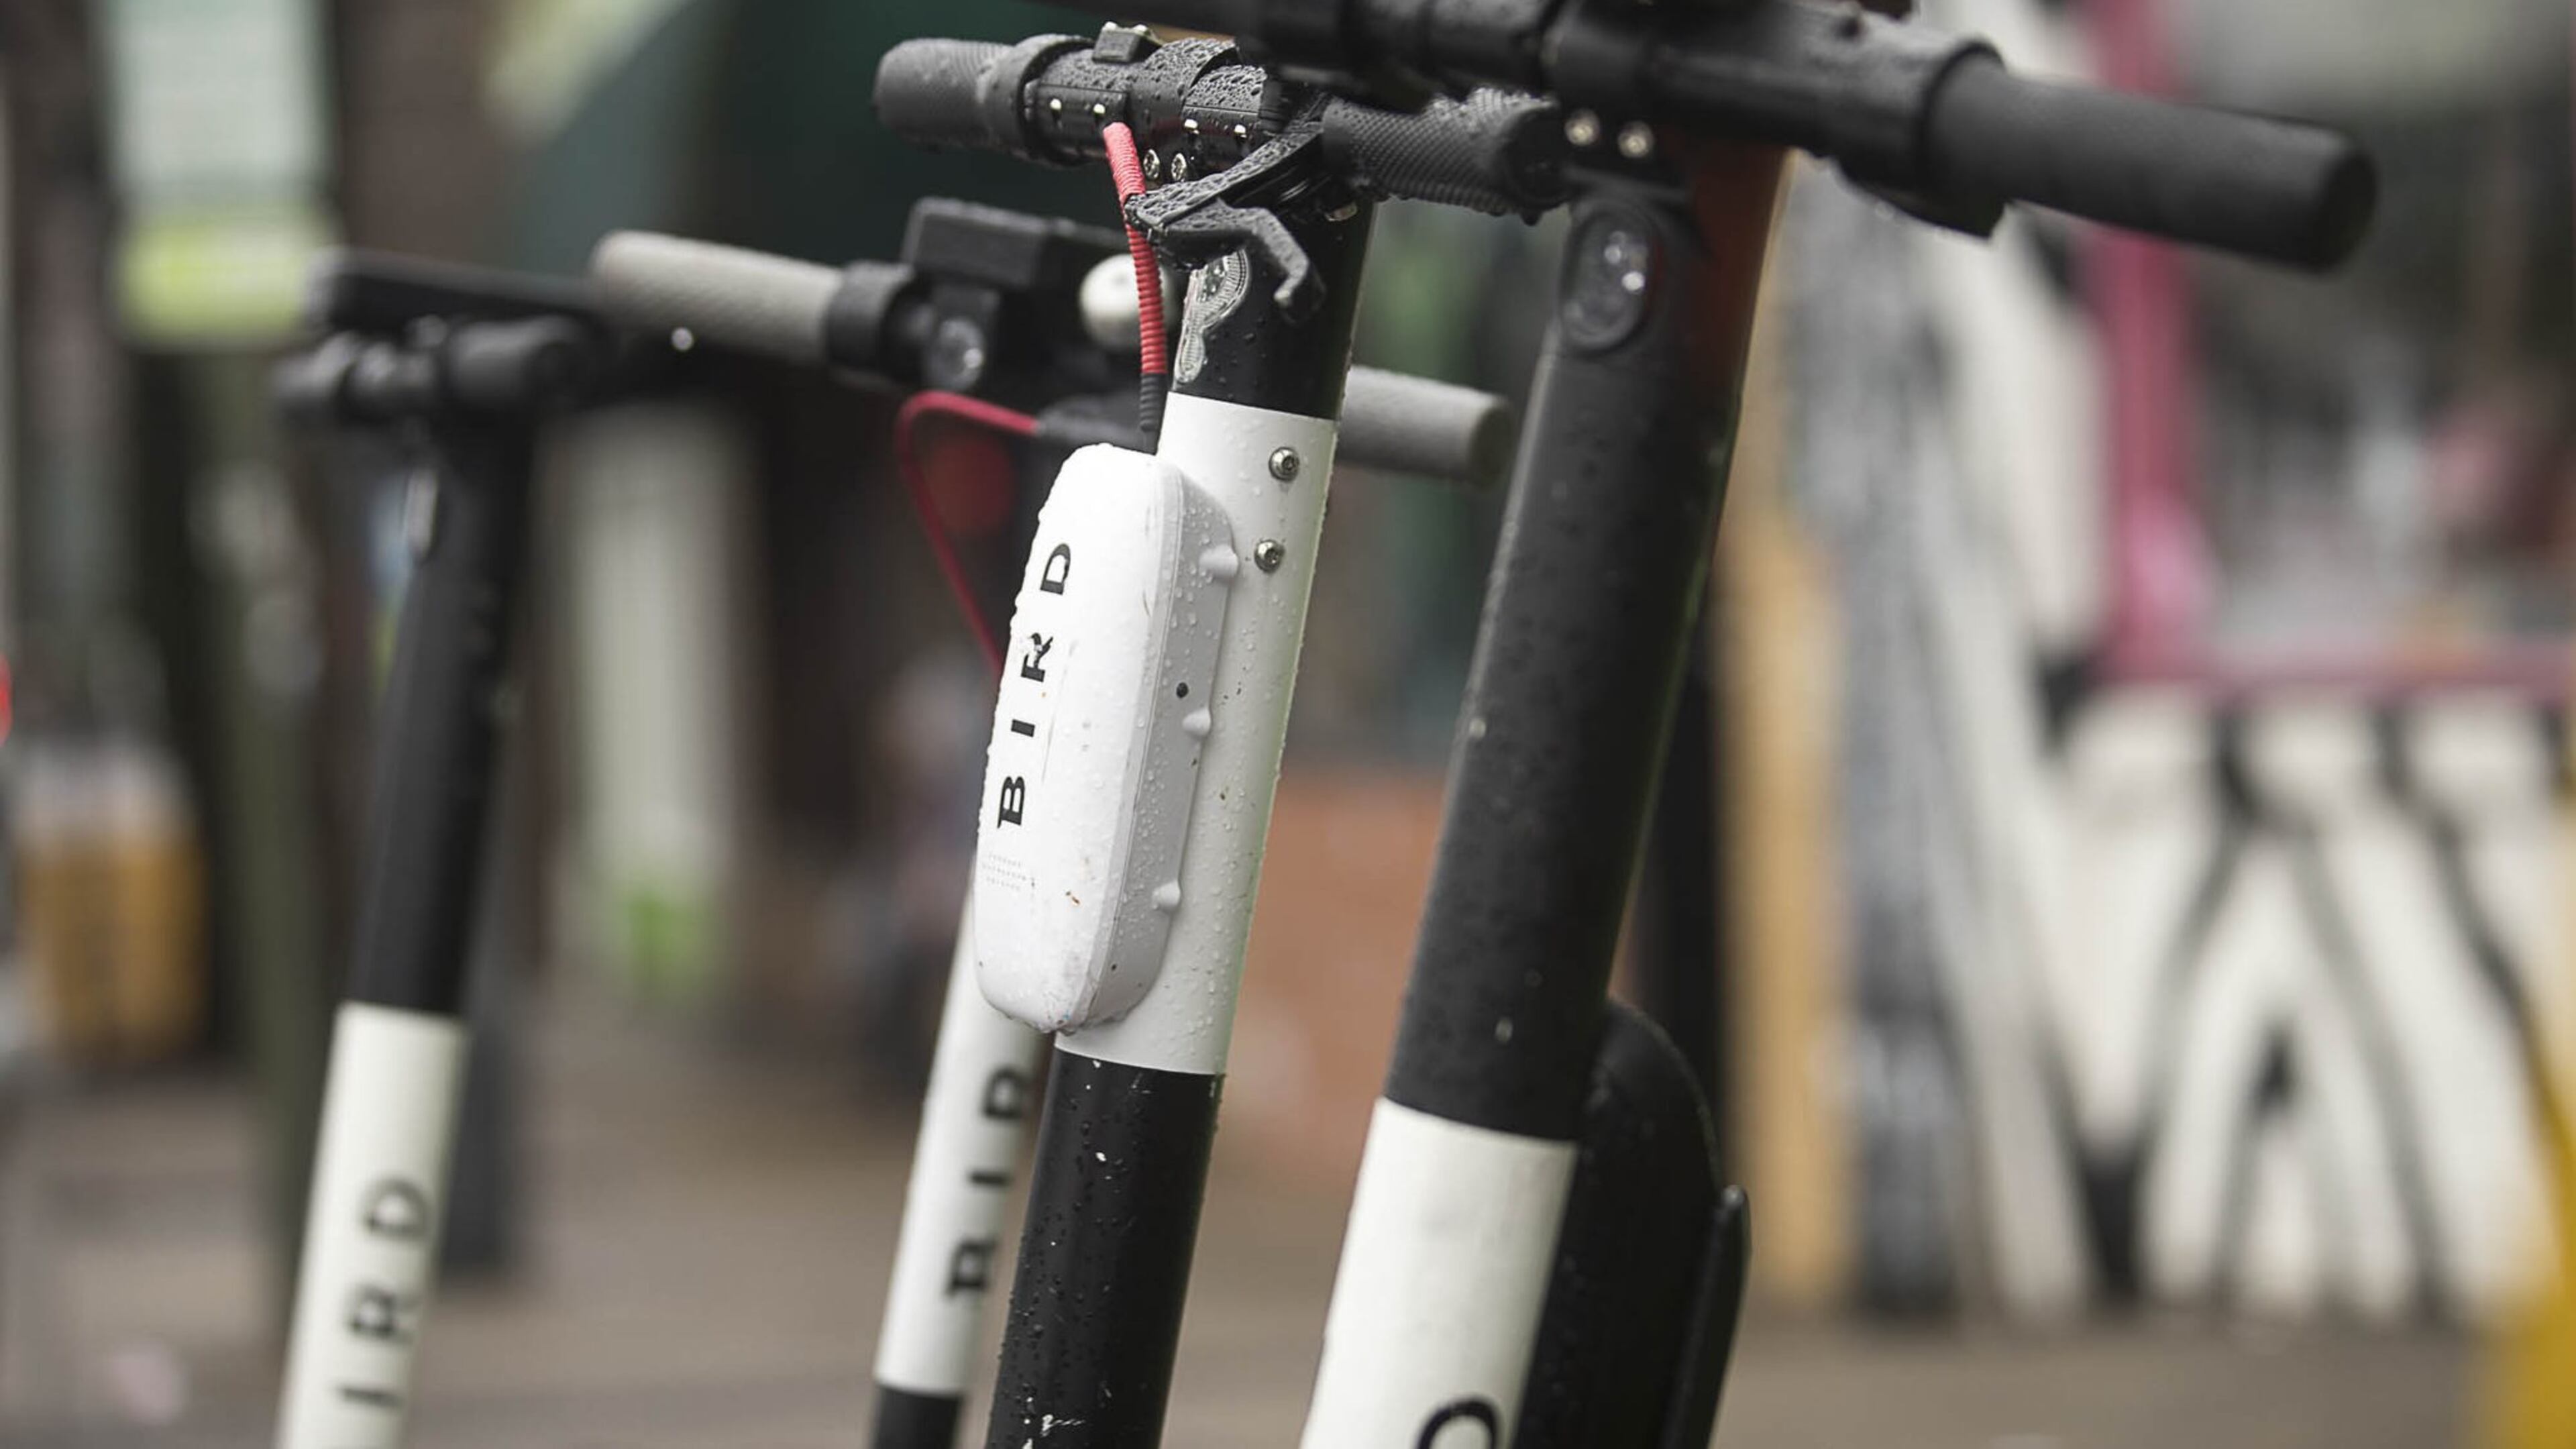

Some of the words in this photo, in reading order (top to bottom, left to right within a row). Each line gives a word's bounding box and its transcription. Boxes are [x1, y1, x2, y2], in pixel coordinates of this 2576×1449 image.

[998, 543, 1071, 829] BIRD
[334, 1175, 431, 1411] IRD
[946, 1067, 1030, 1300] BIR
